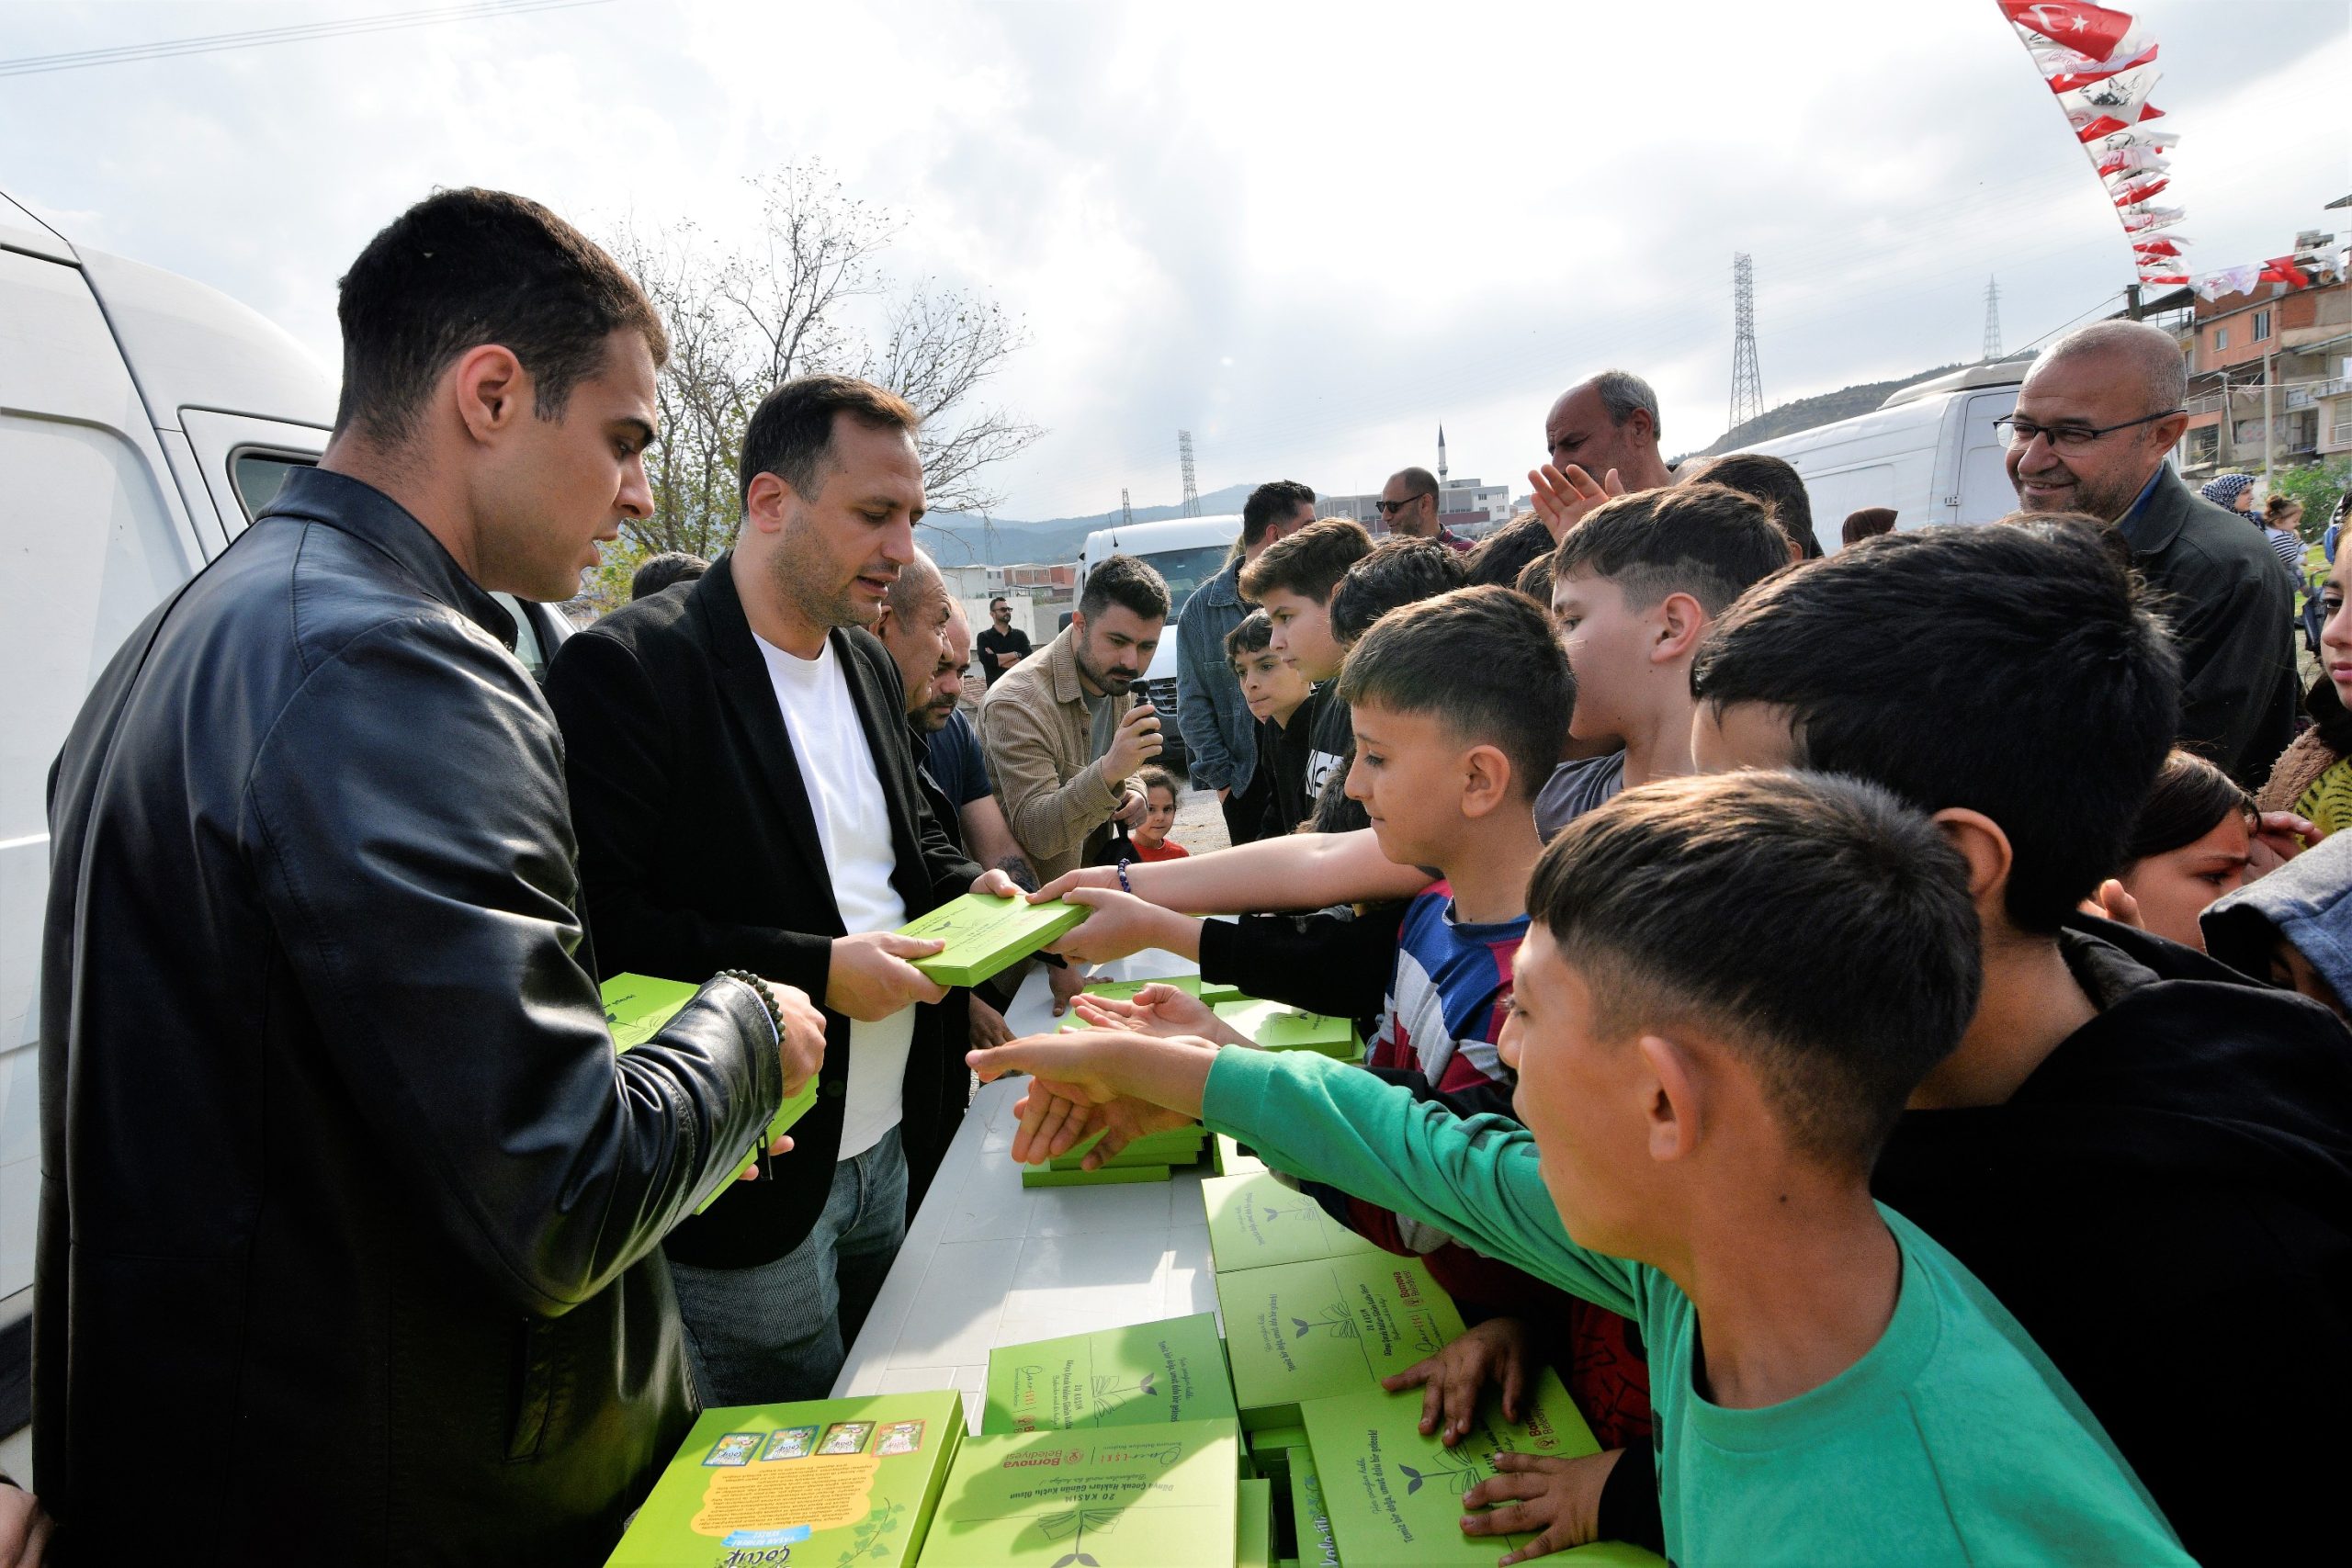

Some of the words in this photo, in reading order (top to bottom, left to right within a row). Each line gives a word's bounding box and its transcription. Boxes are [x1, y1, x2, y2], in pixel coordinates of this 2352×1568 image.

[1393, 1271, 1410, 1298] Bornova
[1402, 1269, 1419, 1296] Belediyesi
[1367, 1429, 1381, 1452] gelecek!
[1006, 1449, 1063, 1461] Belediyesi
[1369, 1453, 1380, 1463] bir
[1003, 1458, 1061, 1469] Bornova
[1371, 1463, 1384, 1477] dolu
[1035, 1487, 1058, 1496] Kutlu
[1060, 1484, 1087, 1493] Günün
[1089, 1483, 1119, 1492] Hakları
[1121, 1483, 1147, 1491] Çocuk
[1148, 1483, 1175, 1492] Dünya
[1375, 1477, 1389, 1495] umut
[1010, 1491, 1034, 1499] Olsun
[1065, 1493, 1098, 1502] KASIM
[1102, 1493, 1115, 1501] 20
[1384, 1495, 1396, 1513] doğa,
[1390, 1513, 1403, 1524] bir
[1396, 1524, 1414, 1543] Temiz
[727, 1545, 790, 1567] Çocuk
